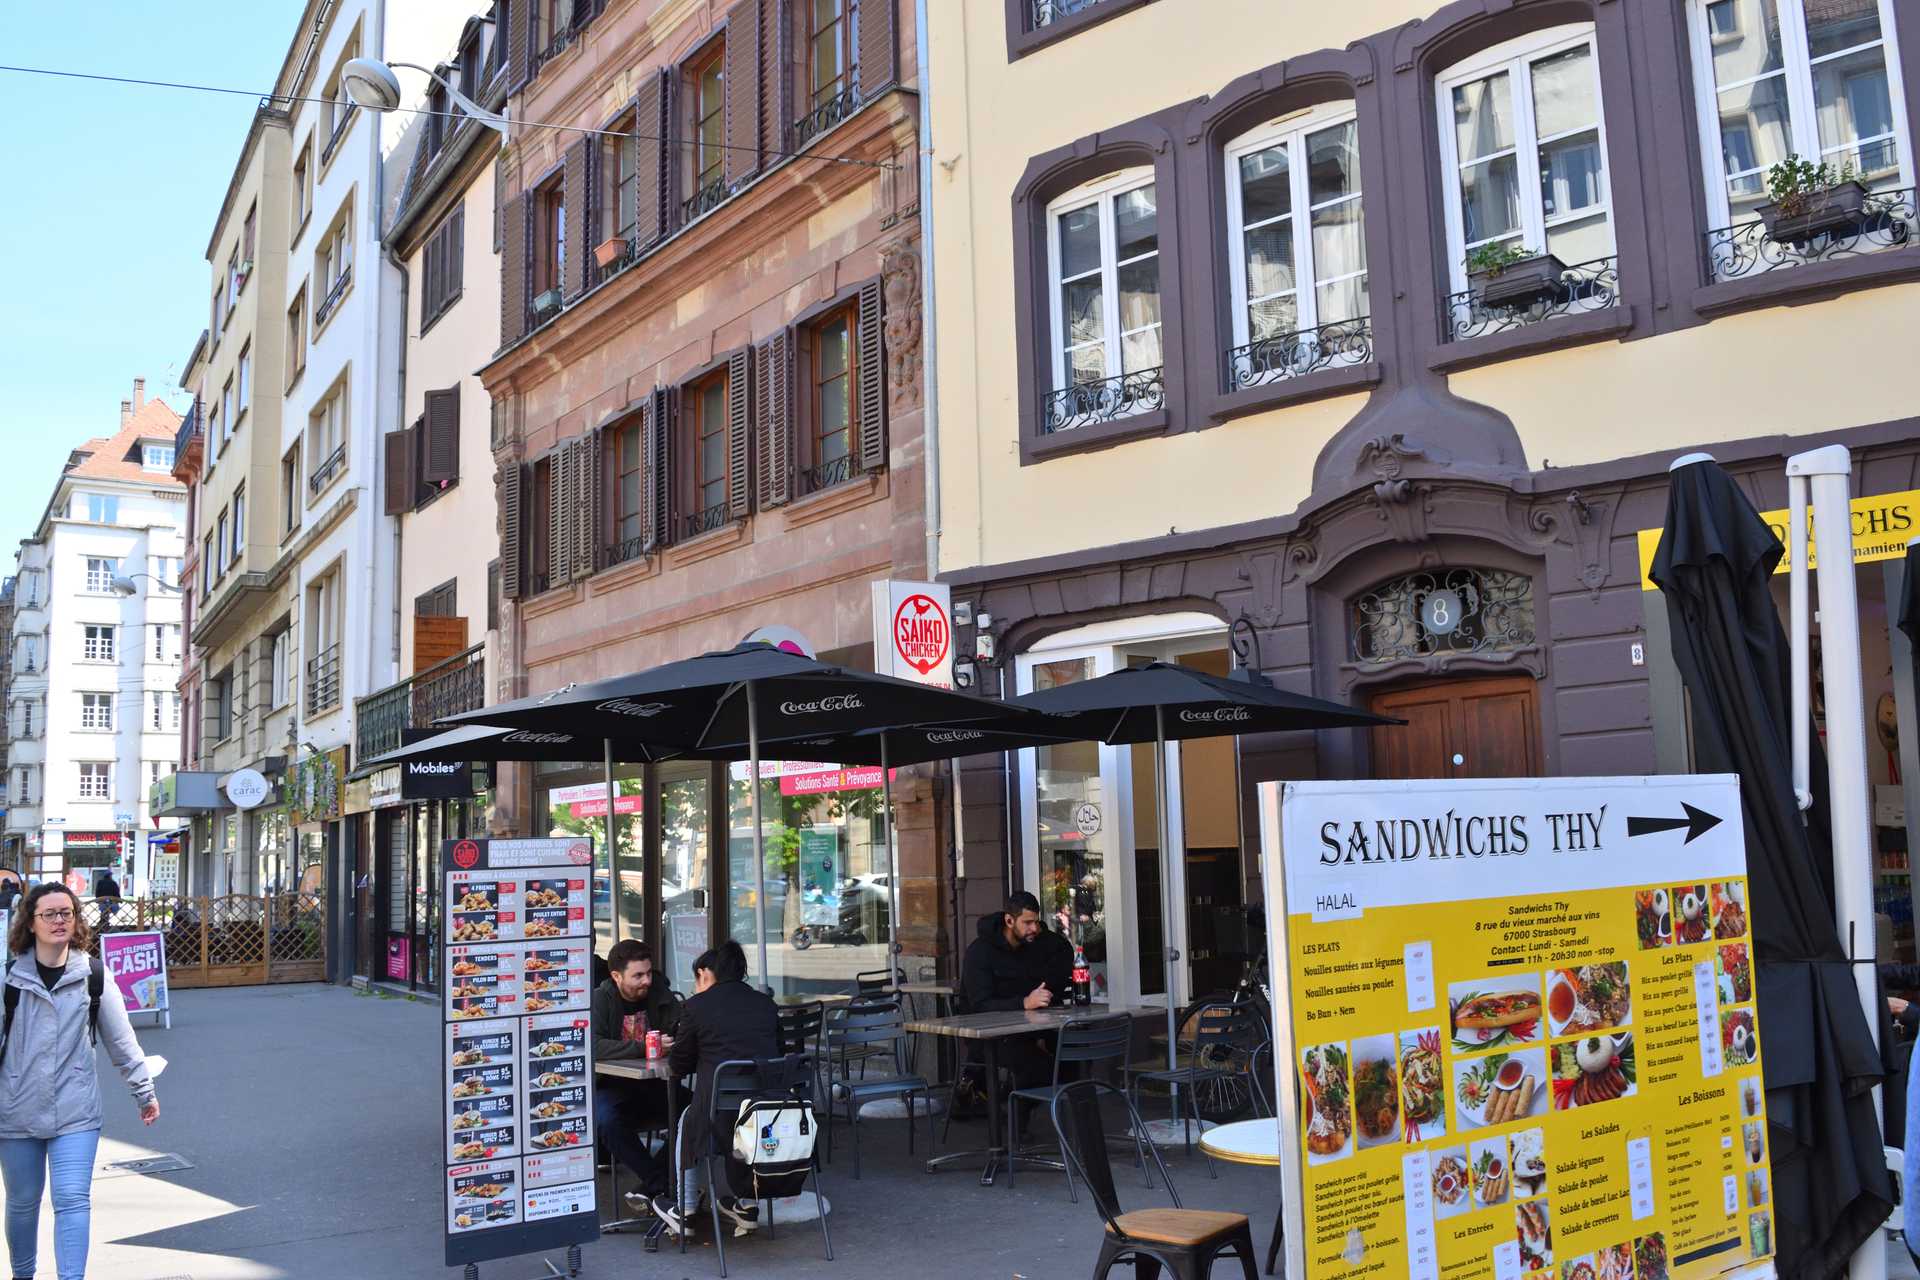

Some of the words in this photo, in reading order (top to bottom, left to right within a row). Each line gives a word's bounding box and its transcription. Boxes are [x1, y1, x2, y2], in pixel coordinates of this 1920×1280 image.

[1433, 598, 1449, 626] 8
[900, 617, 943, 644] SAIKO
[904, 641, 941, 659] CHICKEN
[1634, 647, 1642, 660] 8
[409, 761, 455, 774] Mobiles
[795, 775, 821, 791] Solutions
[822, 771, 839, 788] Santé
[839, 772, 847, 786] &
[847, 770, 882, 788] Prévoyance
[233, 787, 261, 796] carac
[1319, 807, 1529, 866] SANDWICHS
[1545, 804, 1609, 852] THY
[1316, 892, 1357, 913] HALAL
[1508, 902, 1553, 916] Sandwichs
[1554, 901, 1570, 912] Thy
[1474, 921, 1482, 931] 8
[1483, 921, 1498, 930] rue
[1499, 919, 1511, 929] du
[1512, 916, 1535, 928] vieux
[1536, 912, 1567, 925] marché
[1568, 914, 1583, 922] aux
[1584, 911, 1601, 920] vins
[1503, 929, 1531, 941] 67000
[1532, 925, 1577, 938] Strasbourg
[1302, 943, 1316, 955] LES
[1317, 941, 1341, 953] PLATS
[1491, 943, 1527, 956] Contact:
[1528, 940, 1552, 951] Lundi
[1559, 935, 1590, 948] Samedi
[109, 949, 159, 977] CASH
[475, 954, 497, 962] TENDERS
[1527, 953, 1543, 965] 11h
[1550, 951, 1577, 962] 20h30
[1577, 948, 1593, 958] non
[1662, 955, 1674, 966] Les
[1675, 952, 1693, 964] Plats
[1304, 964, 1333, 977] Nouilles
[1333, 960, 1360, 973] sautées
[1360, 960, 1374, 970] aux
[1374, 957, 1405, 970] légumes
[1305, 986, 1334, 999] Nouilles
[1334, 983, 1361, 995] sautées
[1361, 983, 1372, 991] au
[1372, 979, 1395, 992] poulet
[1641, 975, 1651, 985] Riz
[1642, 993, 1652, 1001] Riz
[1306, 1011, 1316, 1021] Bo
[1316, 1008, 1333, 1018] Bun
[1339, 1006, 1356, 1017] Nem
[1678, 1095, 1692, 1106] Les
[1692, 1087, 1726, 1103] Boissons
[1581, 1129, 1593, 1140] Les
[1594, 1122, 1620, 1136] Salades
[1556, 1160, 1578, 1174] Salade
[1578, 1155, 1605, 1170] légumes
[1315, 1177, 1343, 1192] Sandwich
[1343, 1174, 1356, 1186] porc
[1315, 1187, 1343, 1202] Sandwich
[1343, 1186, 1357, 1198] porc
[1365, 1178, 1385, 1190] poulet
[1558, 1180, 1580, 1195] Salade
[1580, 1179, 1588, 1188] de
[1588, 1173, 1609, 1188] poulet
[1315, 1198, 1344, 1213] Sandwich
[1344, 1197, 1357, 1208] porc
[1316, 1209, 1344, 1223] Sandwich
[1344, 1204, 1364, 1217] poulet
[1559, 1201, 1581, 1216] Salade
[1581, 1199, 1590, 1209] de
[1316, 1220, 1344, 1234] Sandwich
[1454, 1230, 1466, 1240] Les
[1467, 1222, 1495, 1236] Entrées
[1561, 1222, 1583, 1237] Salade
[1583, 1220, 1591, 1230] de
[1591, 1212, 1620, 1227] crevettes
[1316, 1231, 1345, 1245] Sandwich
[1317, 1252, 1343, 1265] Formule
